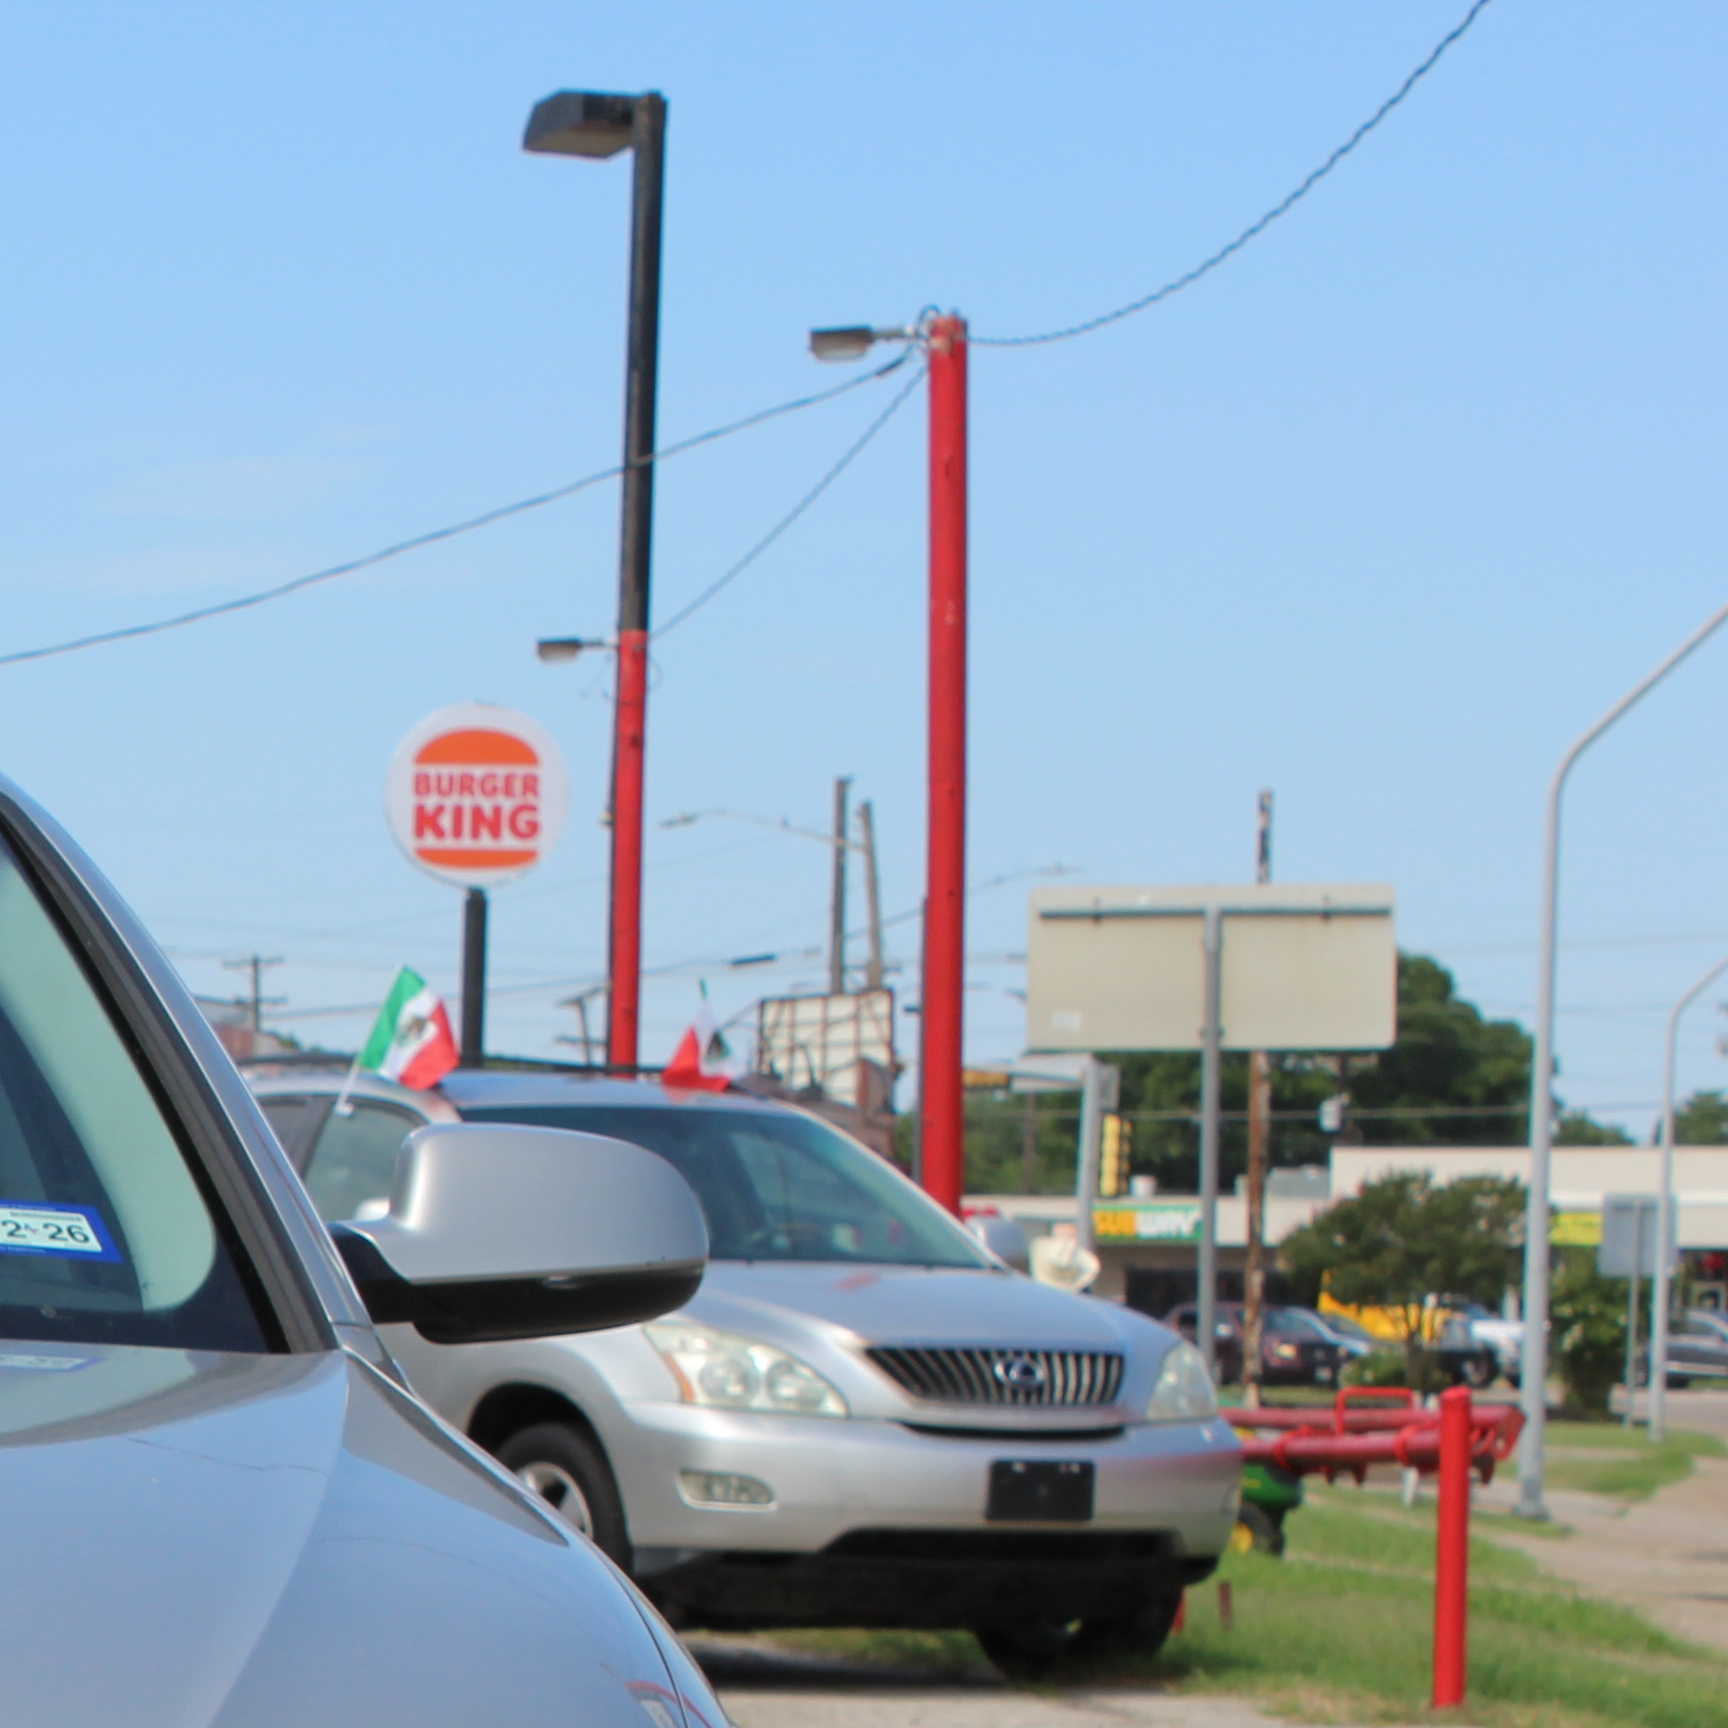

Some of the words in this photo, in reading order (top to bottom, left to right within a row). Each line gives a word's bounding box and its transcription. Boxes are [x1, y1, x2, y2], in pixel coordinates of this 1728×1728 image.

[415, 773, 538, 797] BURGER
[415, 804, 538, 839] KING
[42, 1222, 90, 1243] 26
